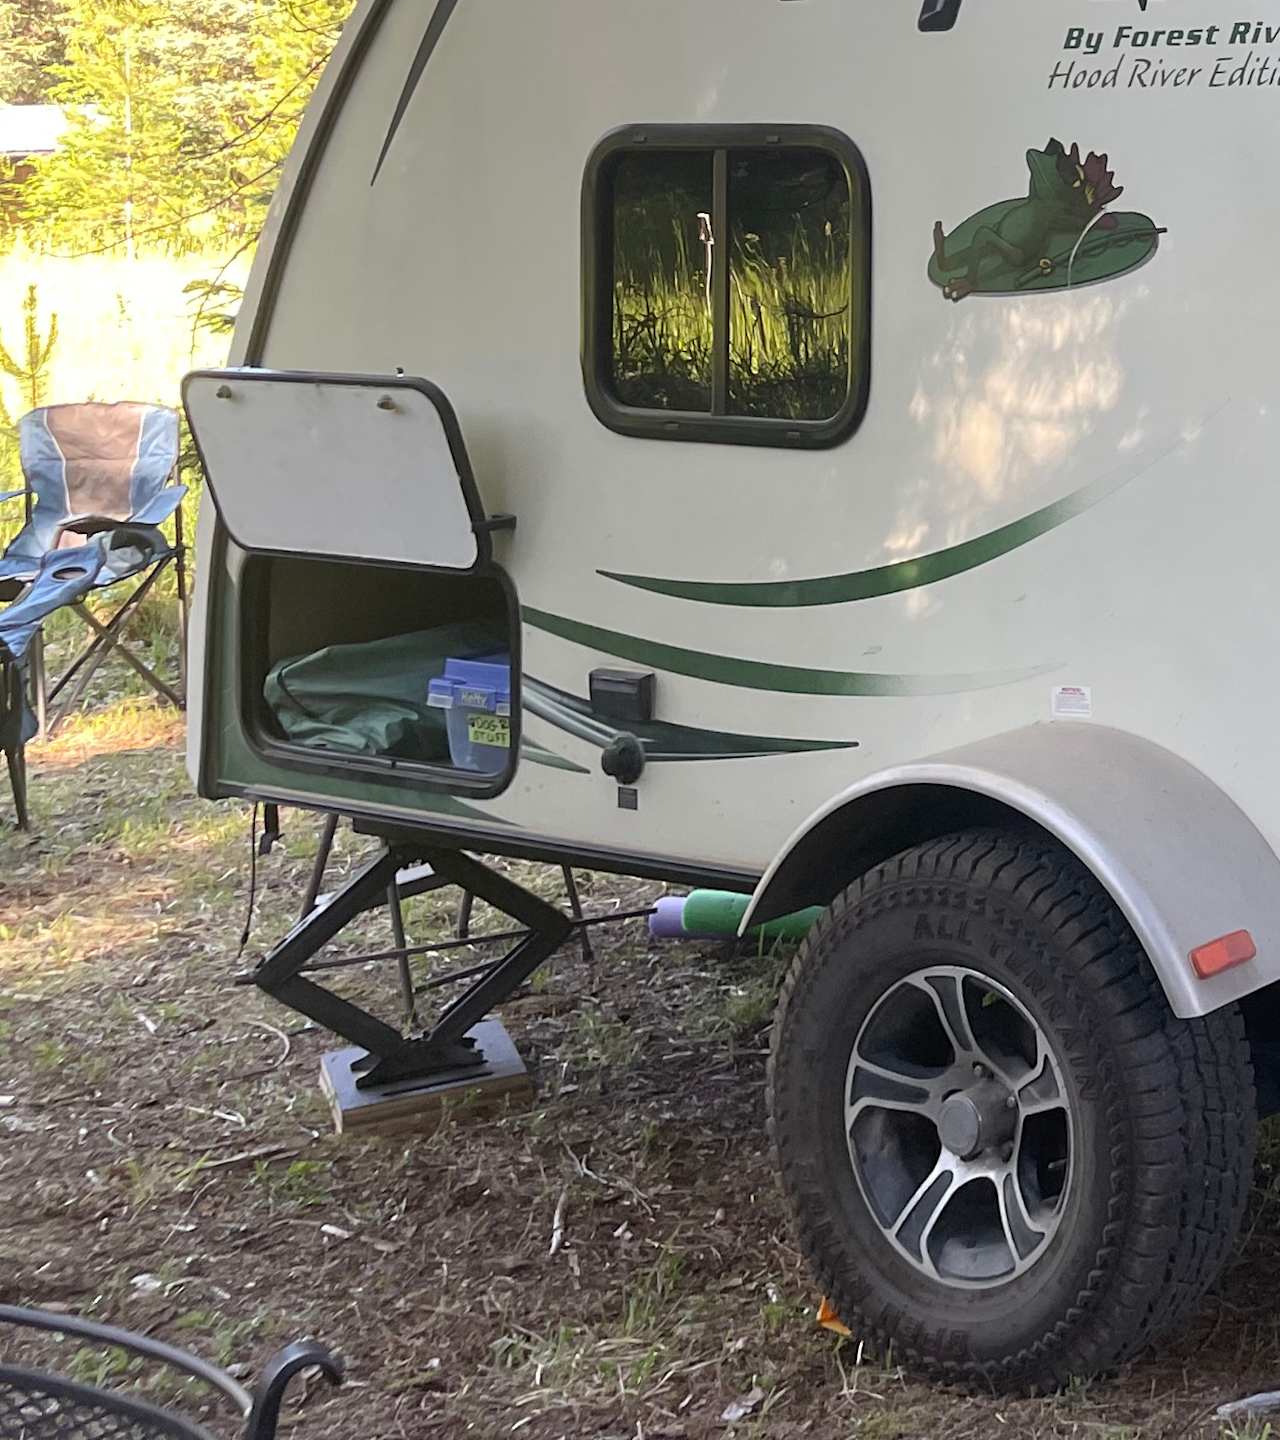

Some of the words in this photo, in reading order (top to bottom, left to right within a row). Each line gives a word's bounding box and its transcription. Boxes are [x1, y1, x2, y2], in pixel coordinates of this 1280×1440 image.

[1063, 27, 1103, 55] By
[1113, 25, 1220, 48] Forest
[1048, 53, 1125, 89] Hood
[1128, 58, 1202, 88] River
